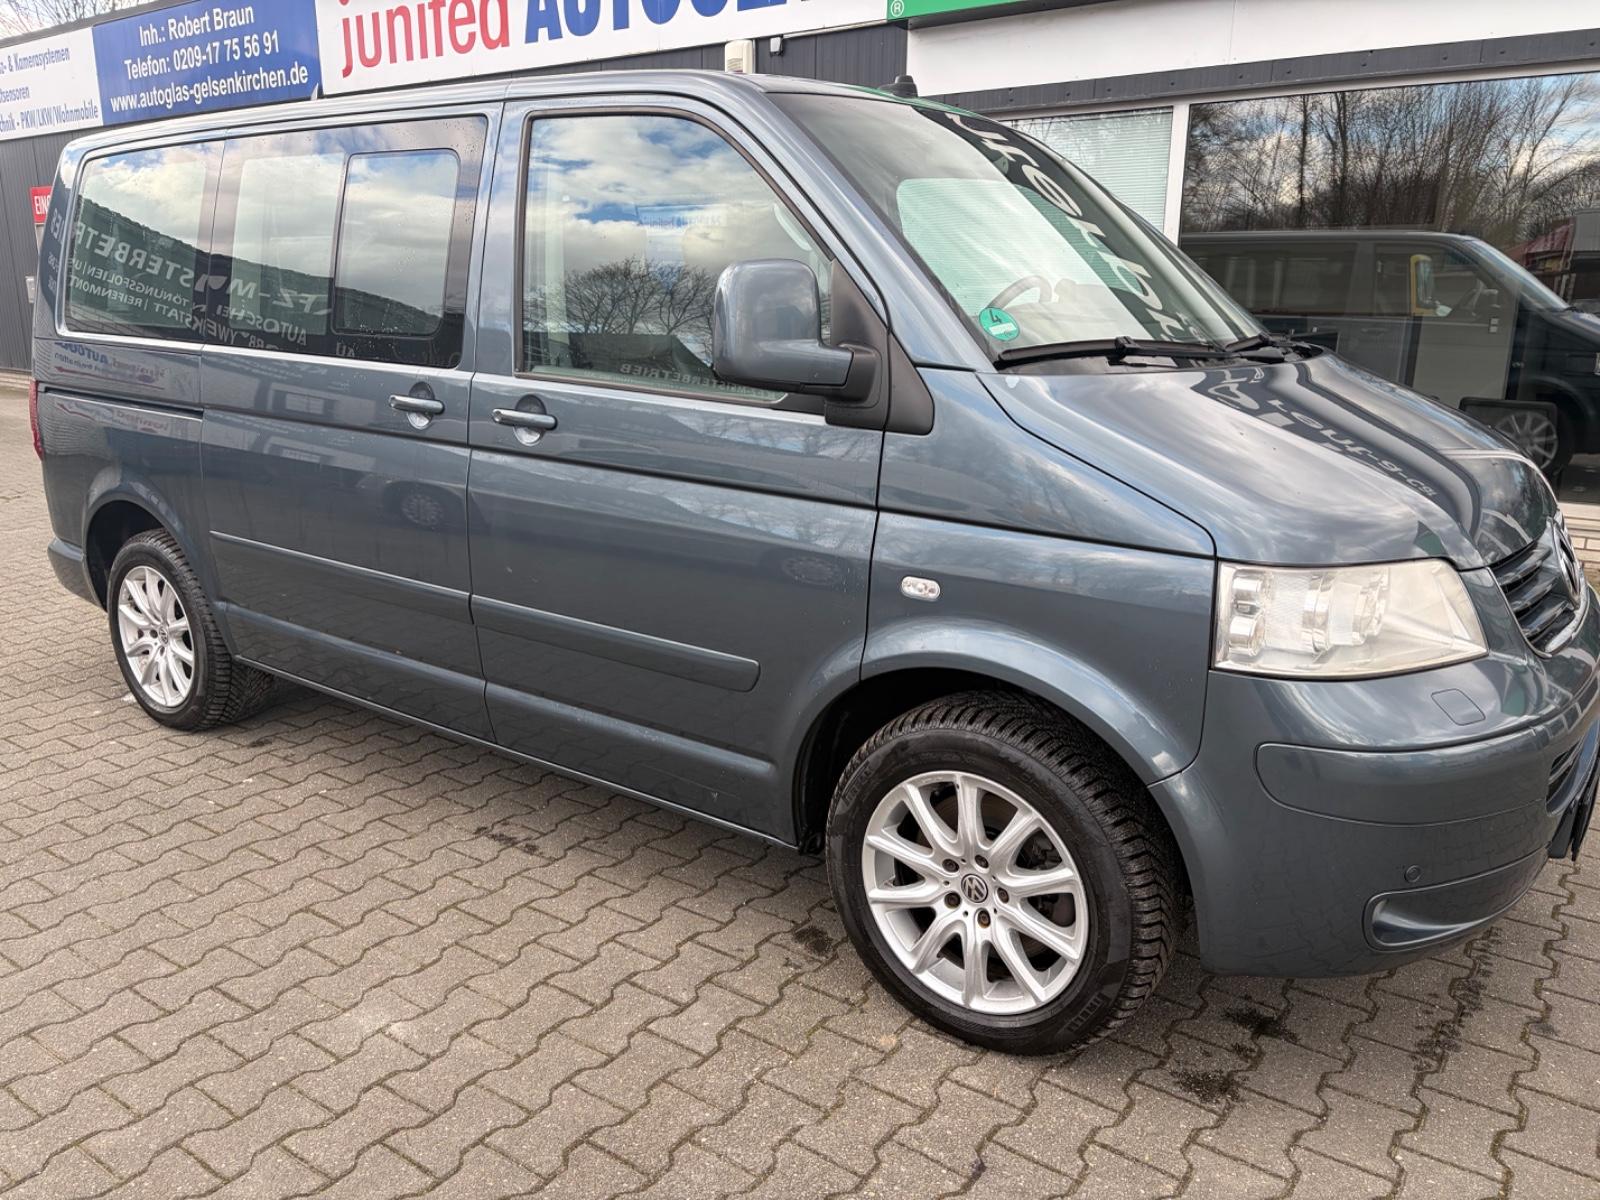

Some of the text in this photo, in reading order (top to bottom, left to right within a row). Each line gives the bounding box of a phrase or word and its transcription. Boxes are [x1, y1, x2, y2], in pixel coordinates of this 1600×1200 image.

[139, 5, 255, 47] Inh.: Robert Braun
[341, 0, 511, 78] junited
[13, 47, 70, 70] Kamerasystemen
[124, 30, 280, 80] Telefon: 0209-17 75 56 91
[110, 61, 309, 112] www.autoglas-gelsenkirchen.de
